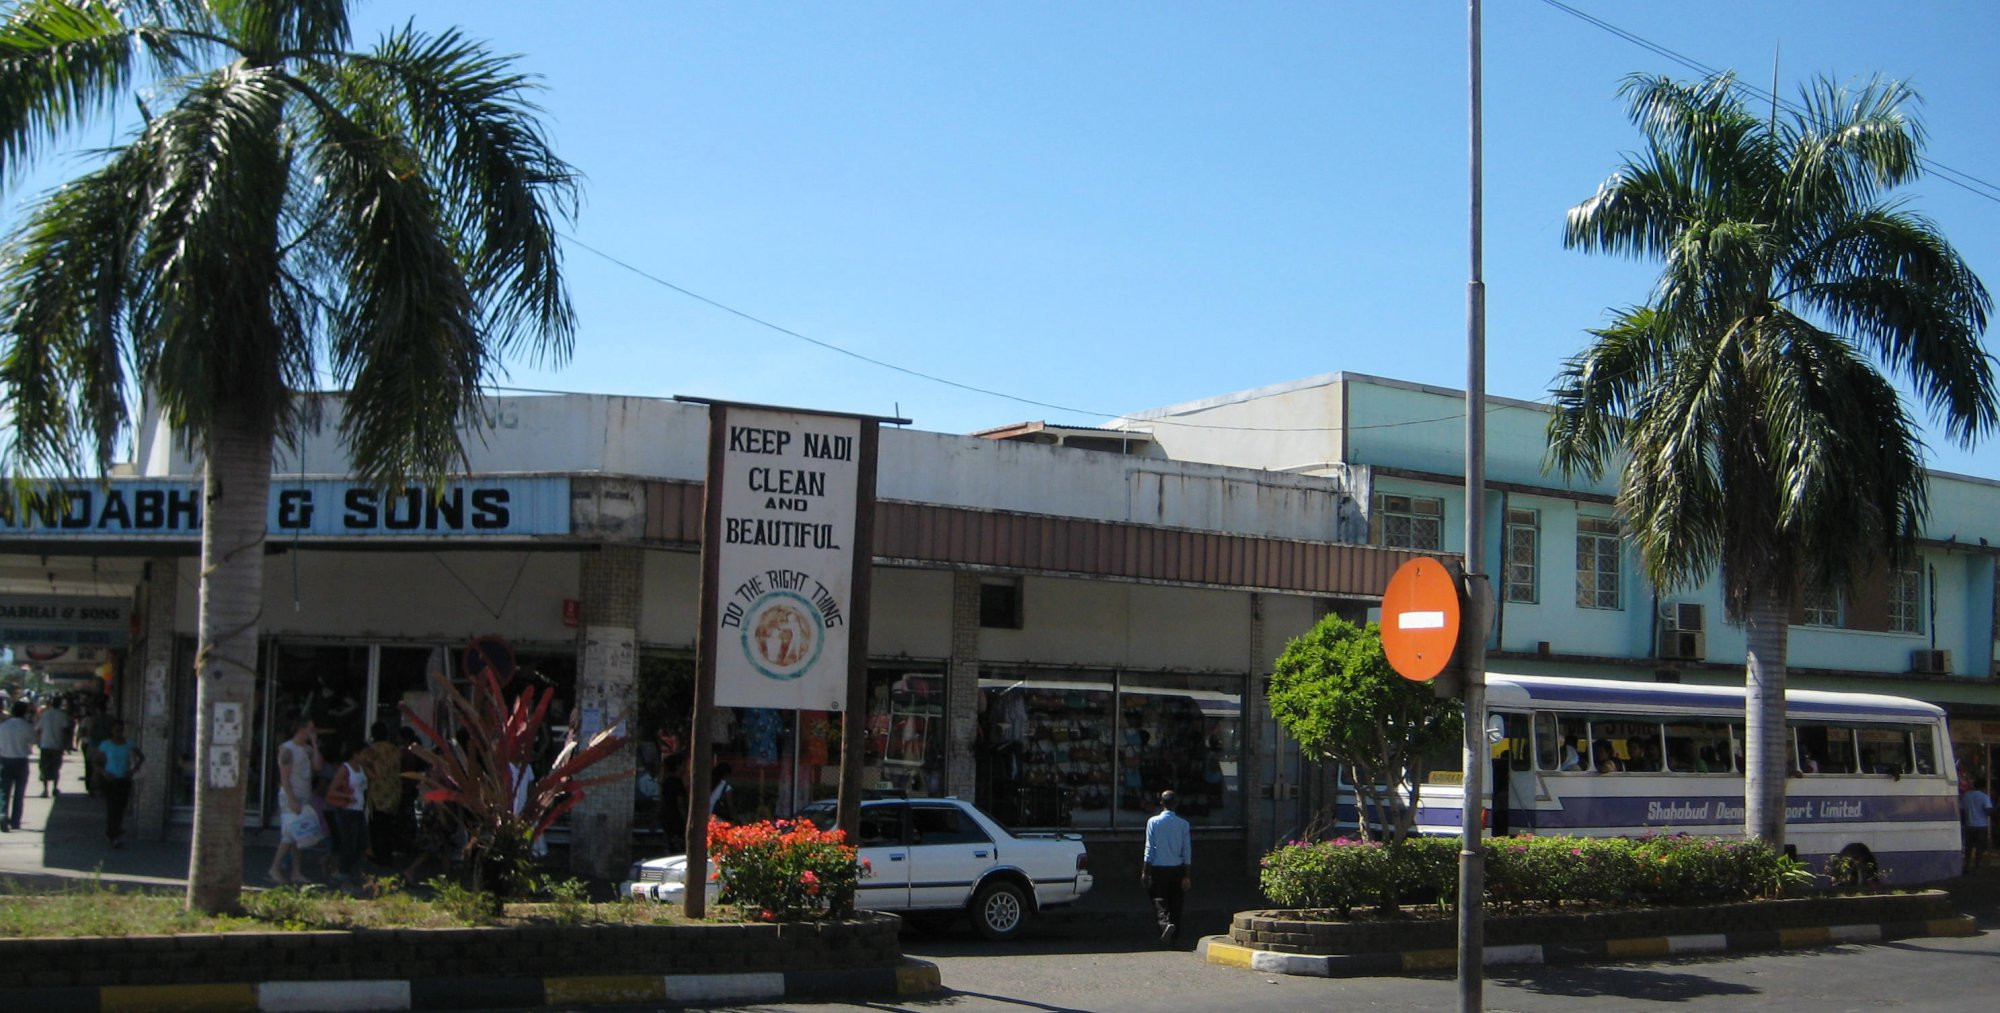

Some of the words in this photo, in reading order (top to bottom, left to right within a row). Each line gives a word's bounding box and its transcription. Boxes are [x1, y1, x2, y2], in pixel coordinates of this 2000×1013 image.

[729, 426, 791, 455] KEEP
[803, 432, 852, 461] NADI
[749, 467, 825, 497] CLEAN
[278, 489, 314, 529] &
[343, 488, 510, 529] SONS
[765, 497, 808, 512] AND
[726, 517, 840, 550] BEAUTIFUL
[80, 608, 120, 619] SONS
[721, 602, 744, 629] DO
[735, 575, 765, 602] THE
[766, 569, 809, 592] RIGHT
[811, 581, 843, 629] THING
[1647, 801, 1709, 819] Shahabud
